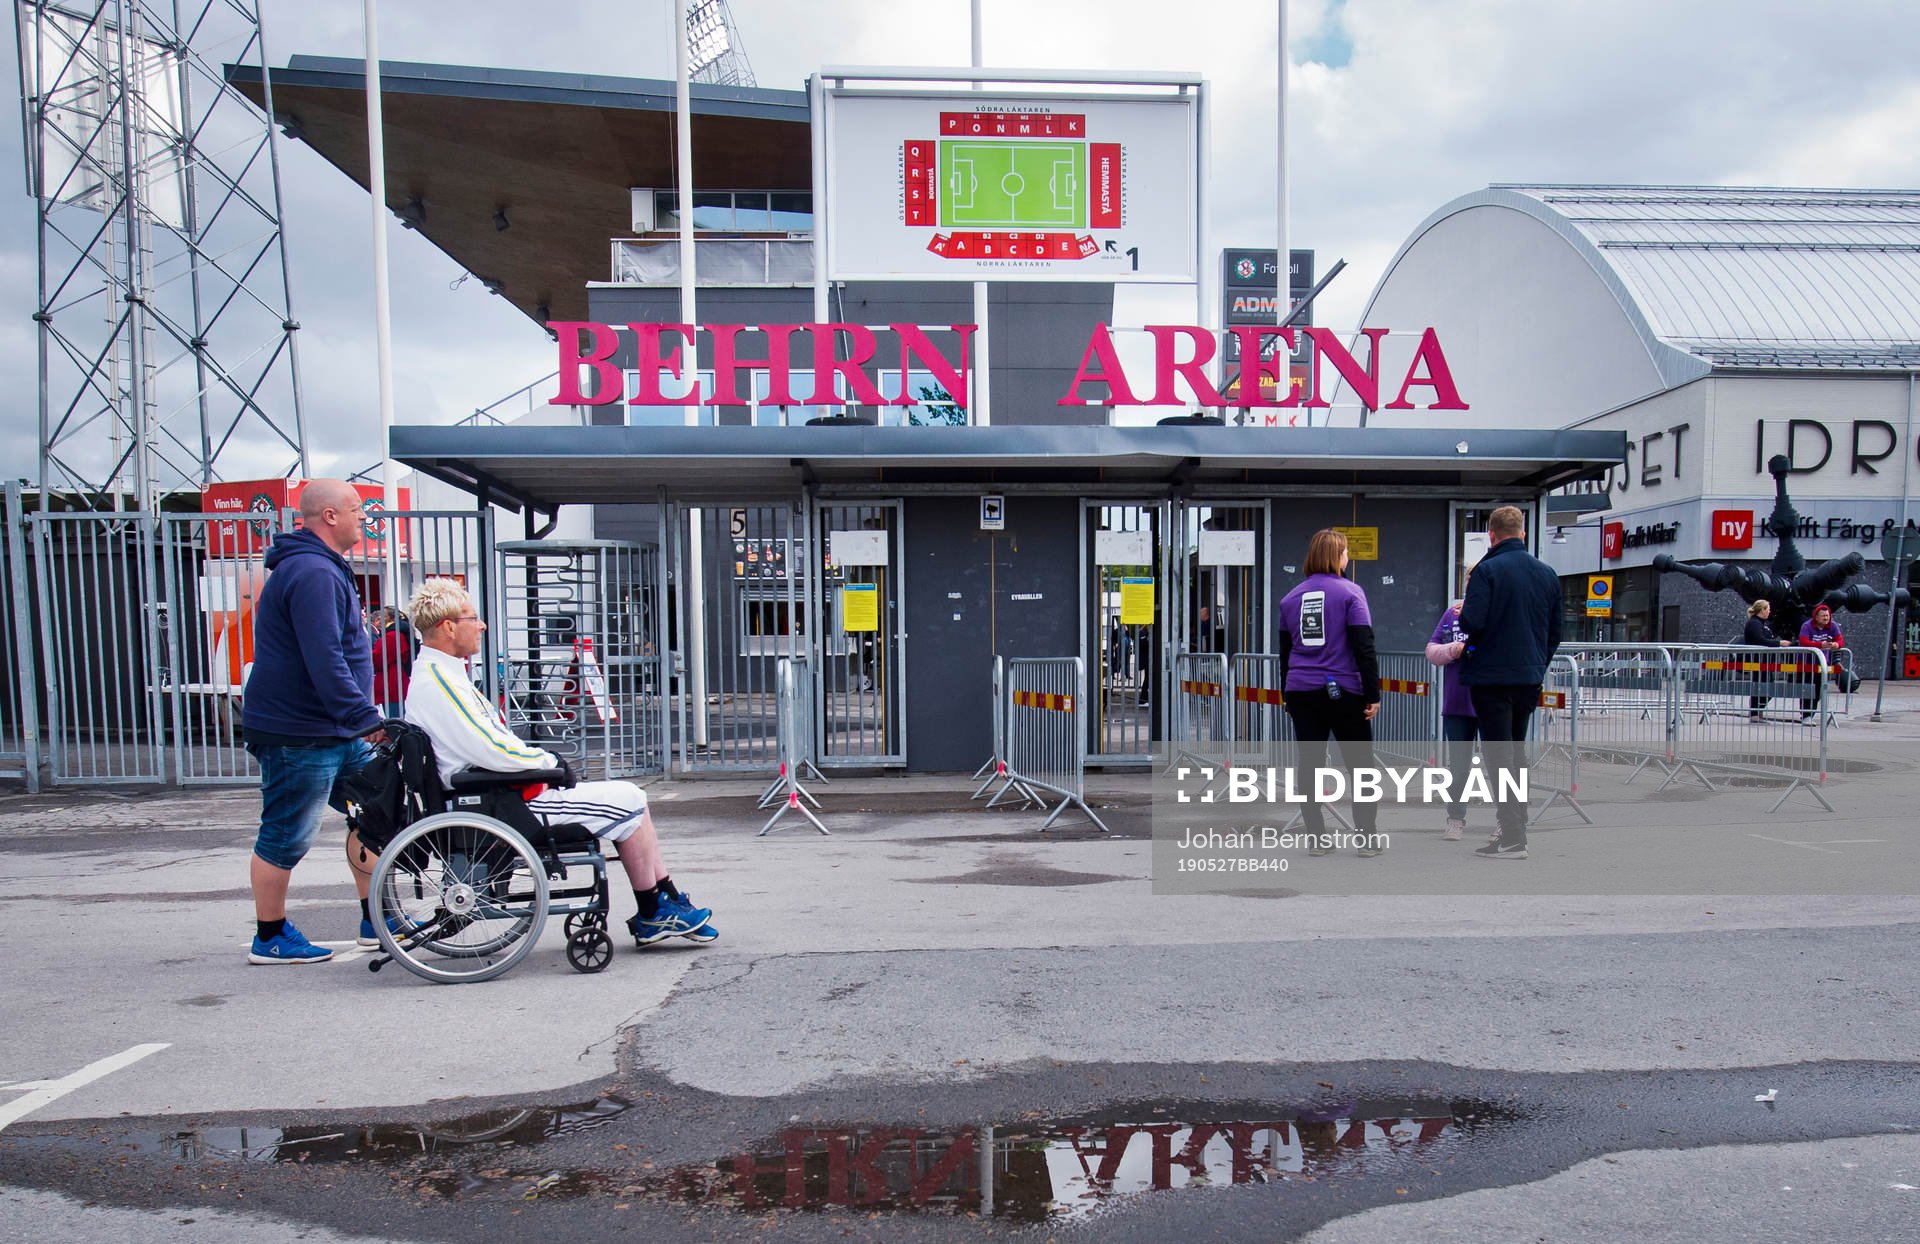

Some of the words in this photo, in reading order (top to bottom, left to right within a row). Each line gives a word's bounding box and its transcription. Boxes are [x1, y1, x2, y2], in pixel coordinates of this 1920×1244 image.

[1006, 105, 1050, 113] LÄKTAREN
[949, 120, 956, 128] P
[973, 124, 981, 132] O
[997, 124, 1005, 133] N
[1069, 122, 1077, 131] K
[1020, 125, 1030, 133] M
[1046, 125, 1052, 133] L
[911, 147, 919, 157] Q
[912, 168, 919, 177] R
[1101, 157, 1112, 215] HEMMASTÅ
[912, 190, 919, 199] S
[912, 210, 919, 220] T
[956, 241, 965, 250] A
[984, 245, 992, 254] B
[1009, 245, 1017, 254] C
[1036, 245, 1044, 254] D
[1061, 242, 1069, 251] E
[1126, 247, 1138, 271] 1
[1263, 263, 1299, 274] Fooll
[546, 321, 979, 408] BEHRN
[1057, 322, 1470, 413] ARENA
[1756, 419, 1920, 475] IDR
[214, 498, 230, 509] Vinn
[730, 510, 745, 535] 5
[192, 522, 206, 547] 4
[1721, 521, 1747, 540] ny
[1761, 516, 1820, 538] Kfft
[1827, 518, 1875, 545] Färg
[1605, 533, 1616, 551] ny
